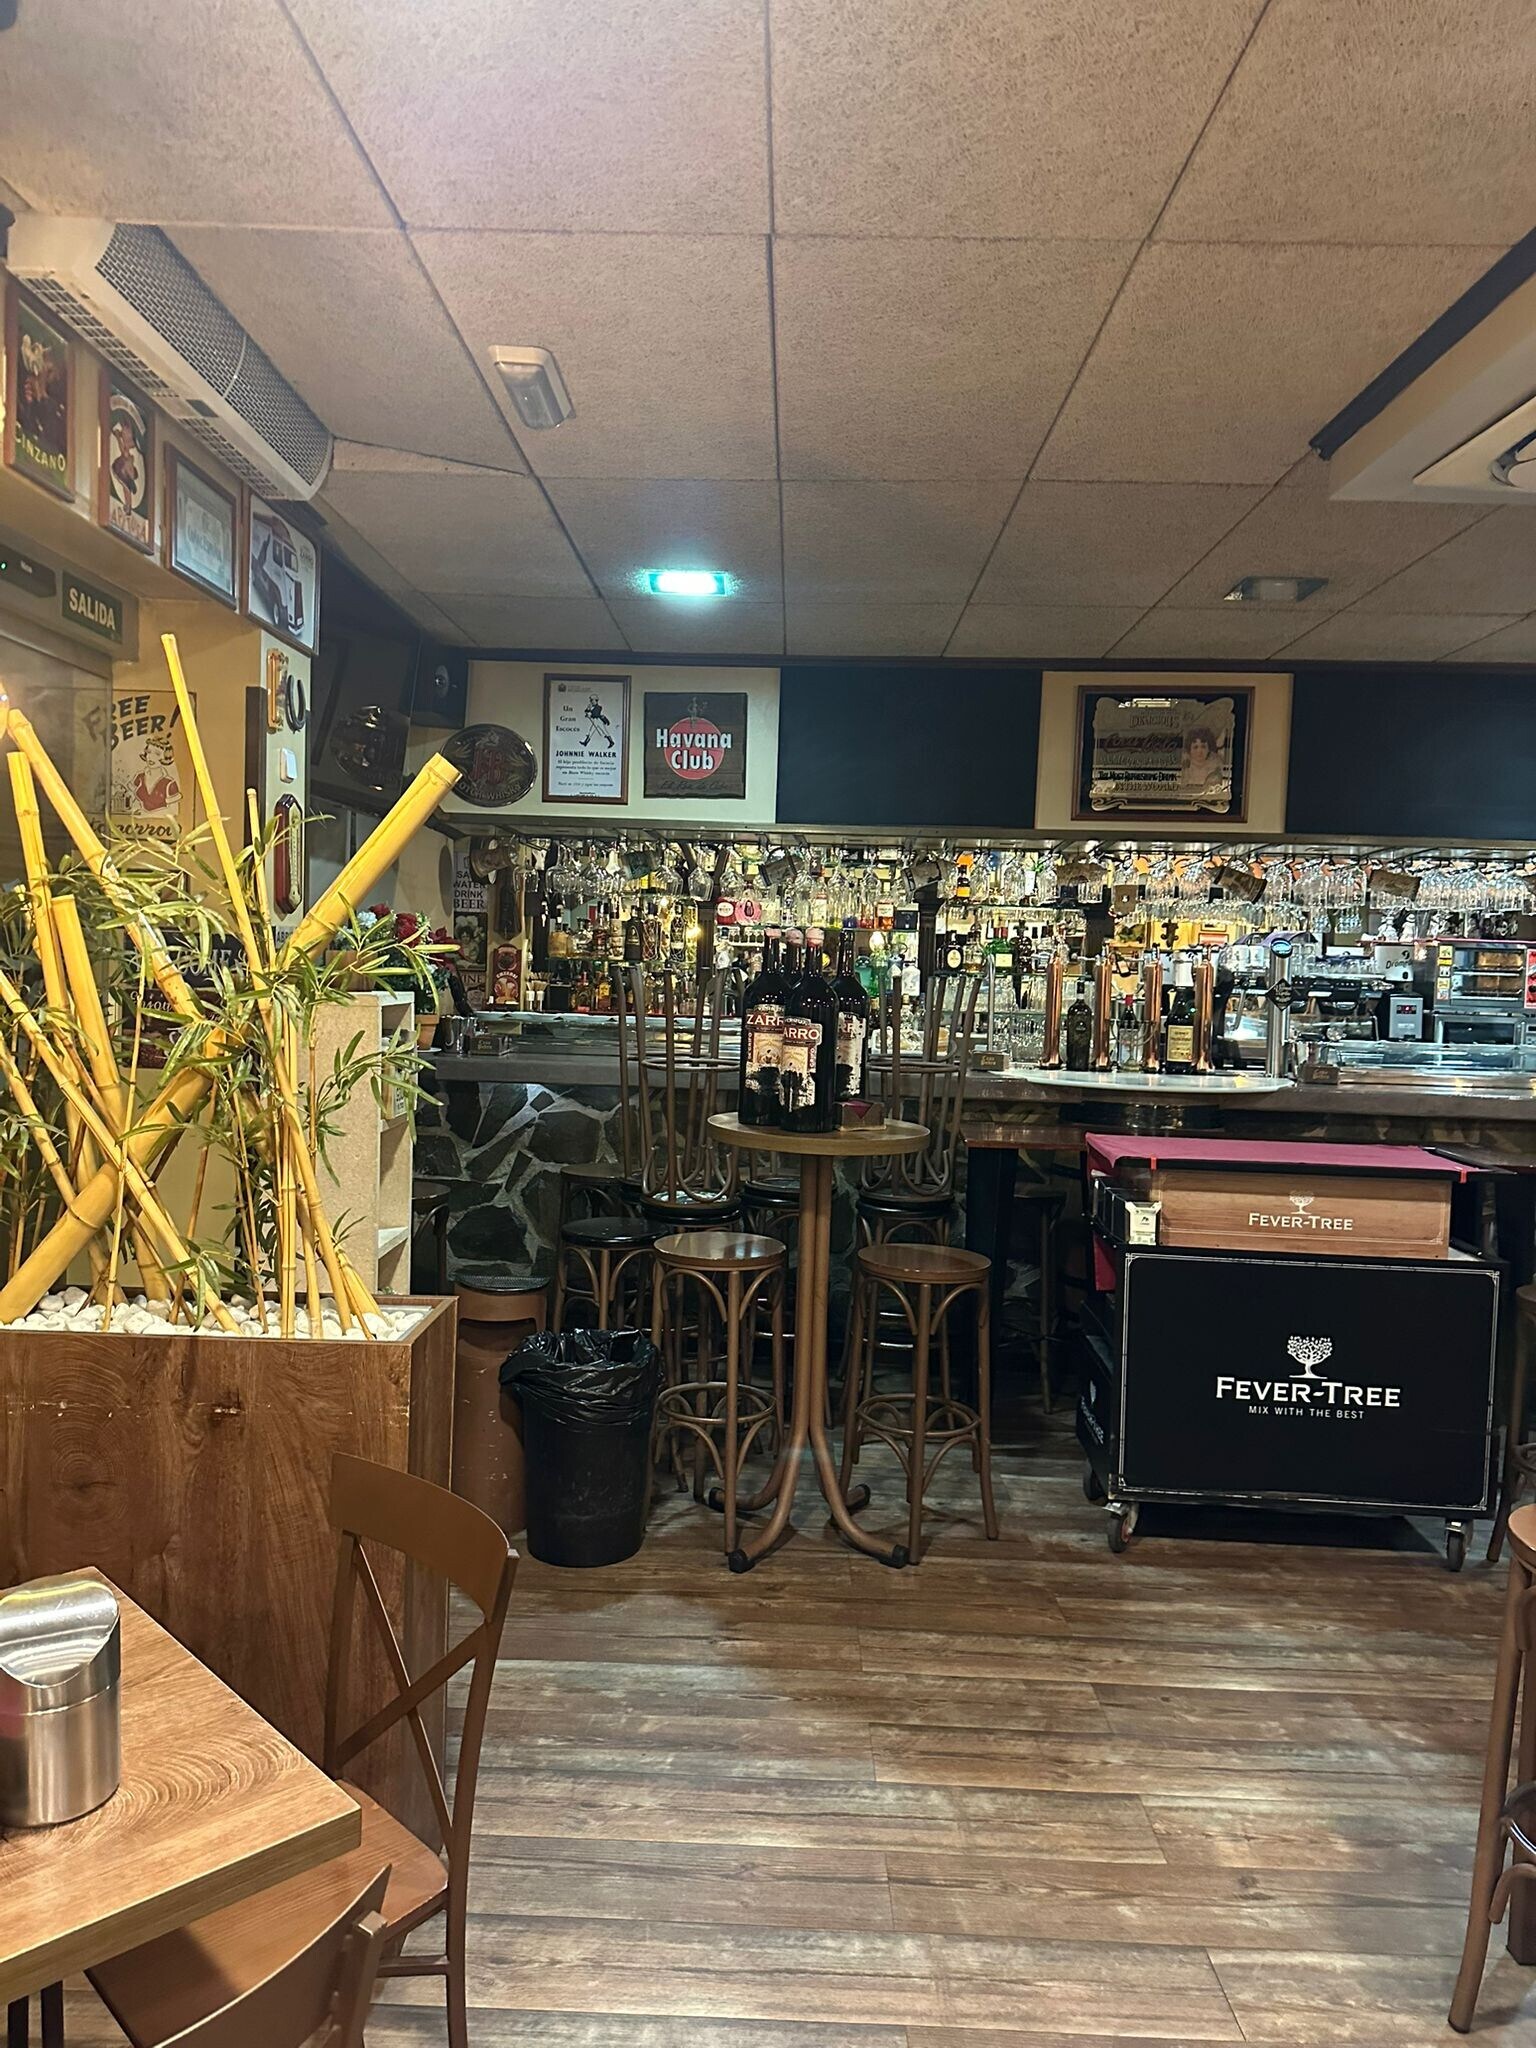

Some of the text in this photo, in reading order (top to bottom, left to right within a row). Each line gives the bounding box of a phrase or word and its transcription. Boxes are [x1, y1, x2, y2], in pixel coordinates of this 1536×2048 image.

[69, 587, 115, 630] SALIDA
[656, 728, 732, 748] Havana
[556, 750, 584, 758] JOHNNIE
[671, 750, 714, 770] Club
[454, 890, 483, 899] DRINK
[453, 899, 485, 909] BEER
[746, 1014, 785, 1026] ZARR
[783, 1027, 820, 1040] ARRO
[1216, 1376, 1401, 1407] FEVER-TREE
[1249, 1405, 1365, 1420] MIX WITH THE BEST
